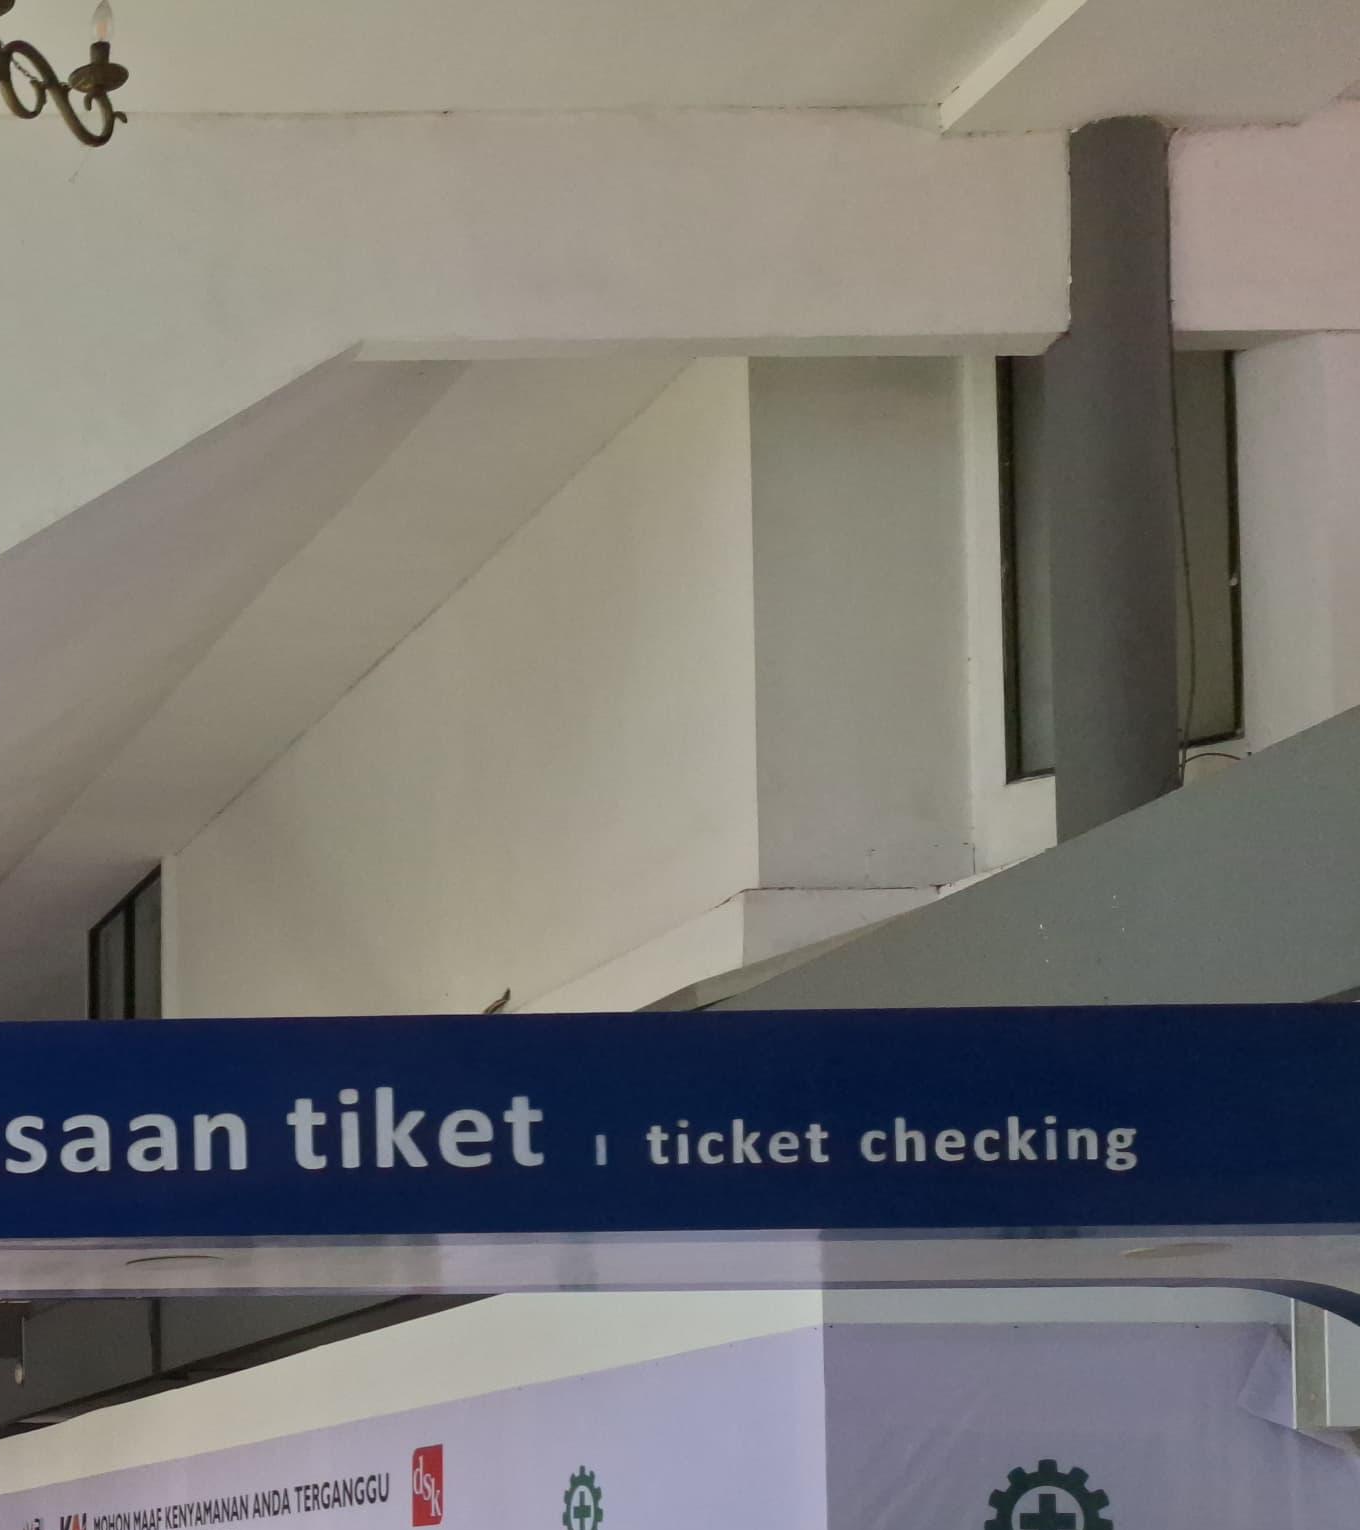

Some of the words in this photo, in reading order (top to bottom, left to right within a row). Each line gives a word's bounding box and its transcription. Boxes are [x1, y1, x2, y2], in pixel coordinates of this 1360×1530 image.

[285, 1087, 545, 1170] tiket
[646, 1119, 829, 1165] ticket
[860, 1115, 1138, 1171] checking
[165, 1495, 249, 1530] KENYAMANAN
[252, 1487, 291, 1518] ANDA
[294, 1472, 390, 1513] TERGANGGU
[413, 1455, 442, 1517] dsk
